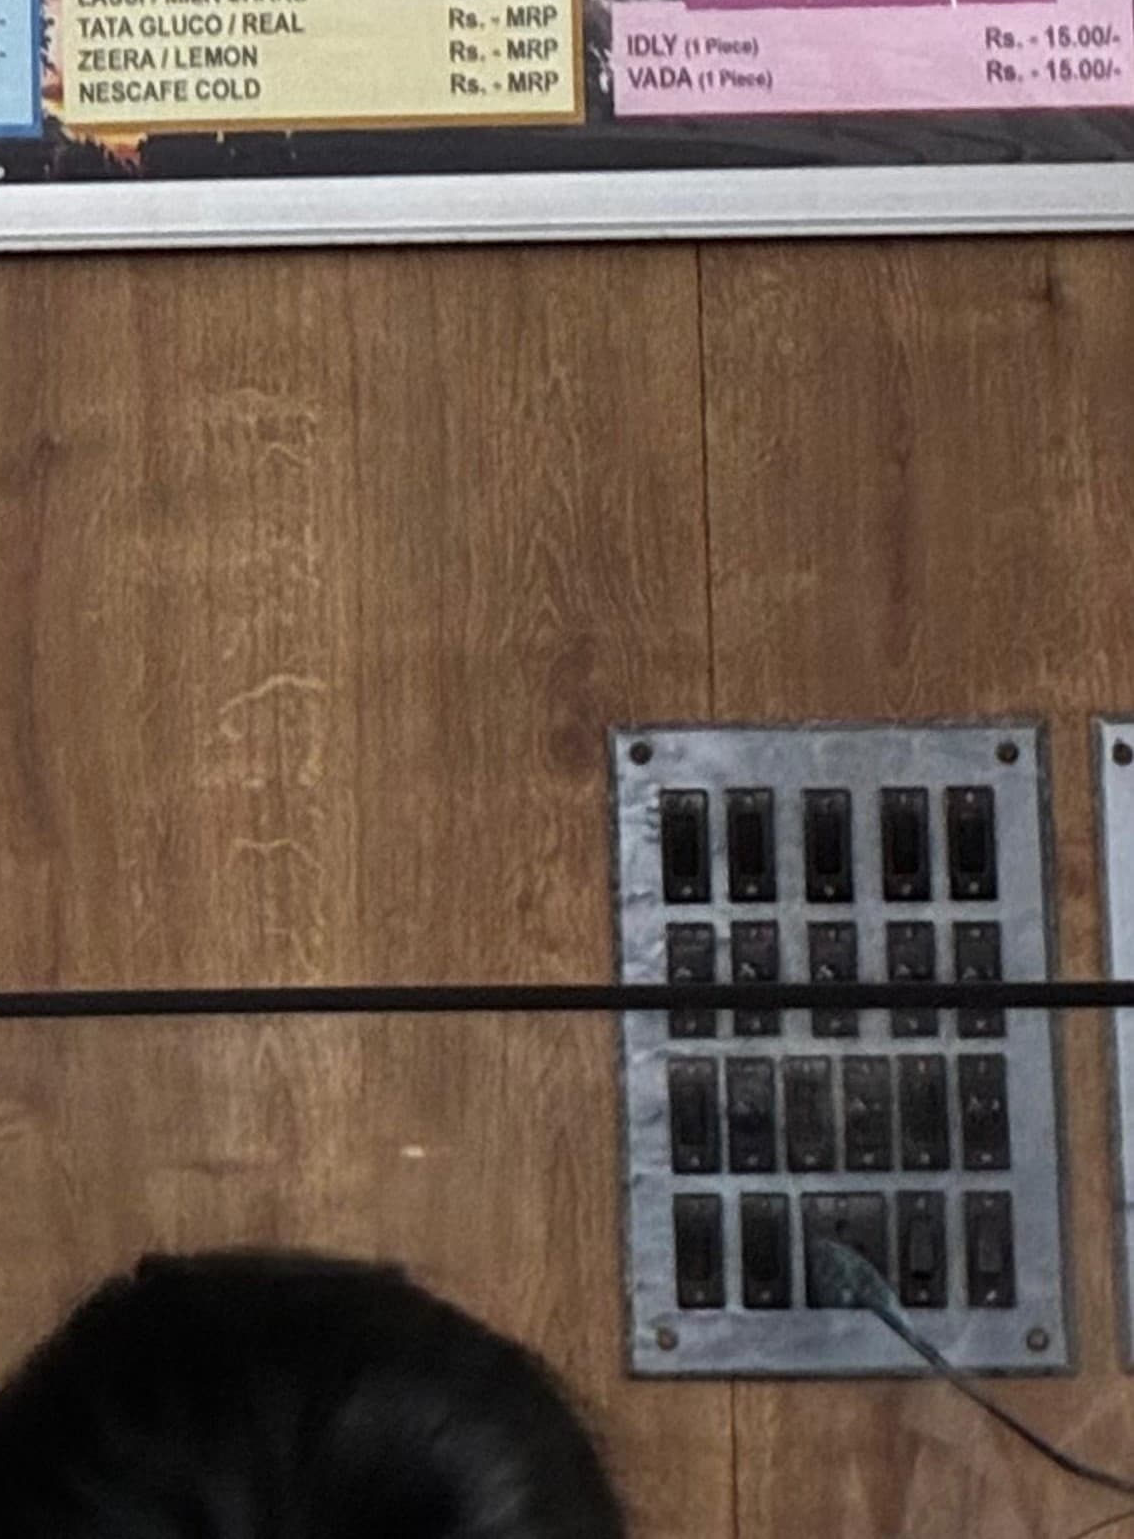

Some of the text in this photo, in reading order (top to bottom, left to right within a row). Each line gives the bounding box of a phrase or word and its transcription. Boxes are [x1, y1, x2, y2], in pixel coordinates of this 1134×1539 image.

[78, 13, 305, 37] TATA GLUCO REAL
[627, 26, 1121, 56] IDLY Rs. 15.00/-
[79, 45, 258, 70] ZEERA LEMON
[628, 59, 1122, 88] VADA Rs. 15.00/-
[79, 79, 260, 102] NESCAFE COLD
